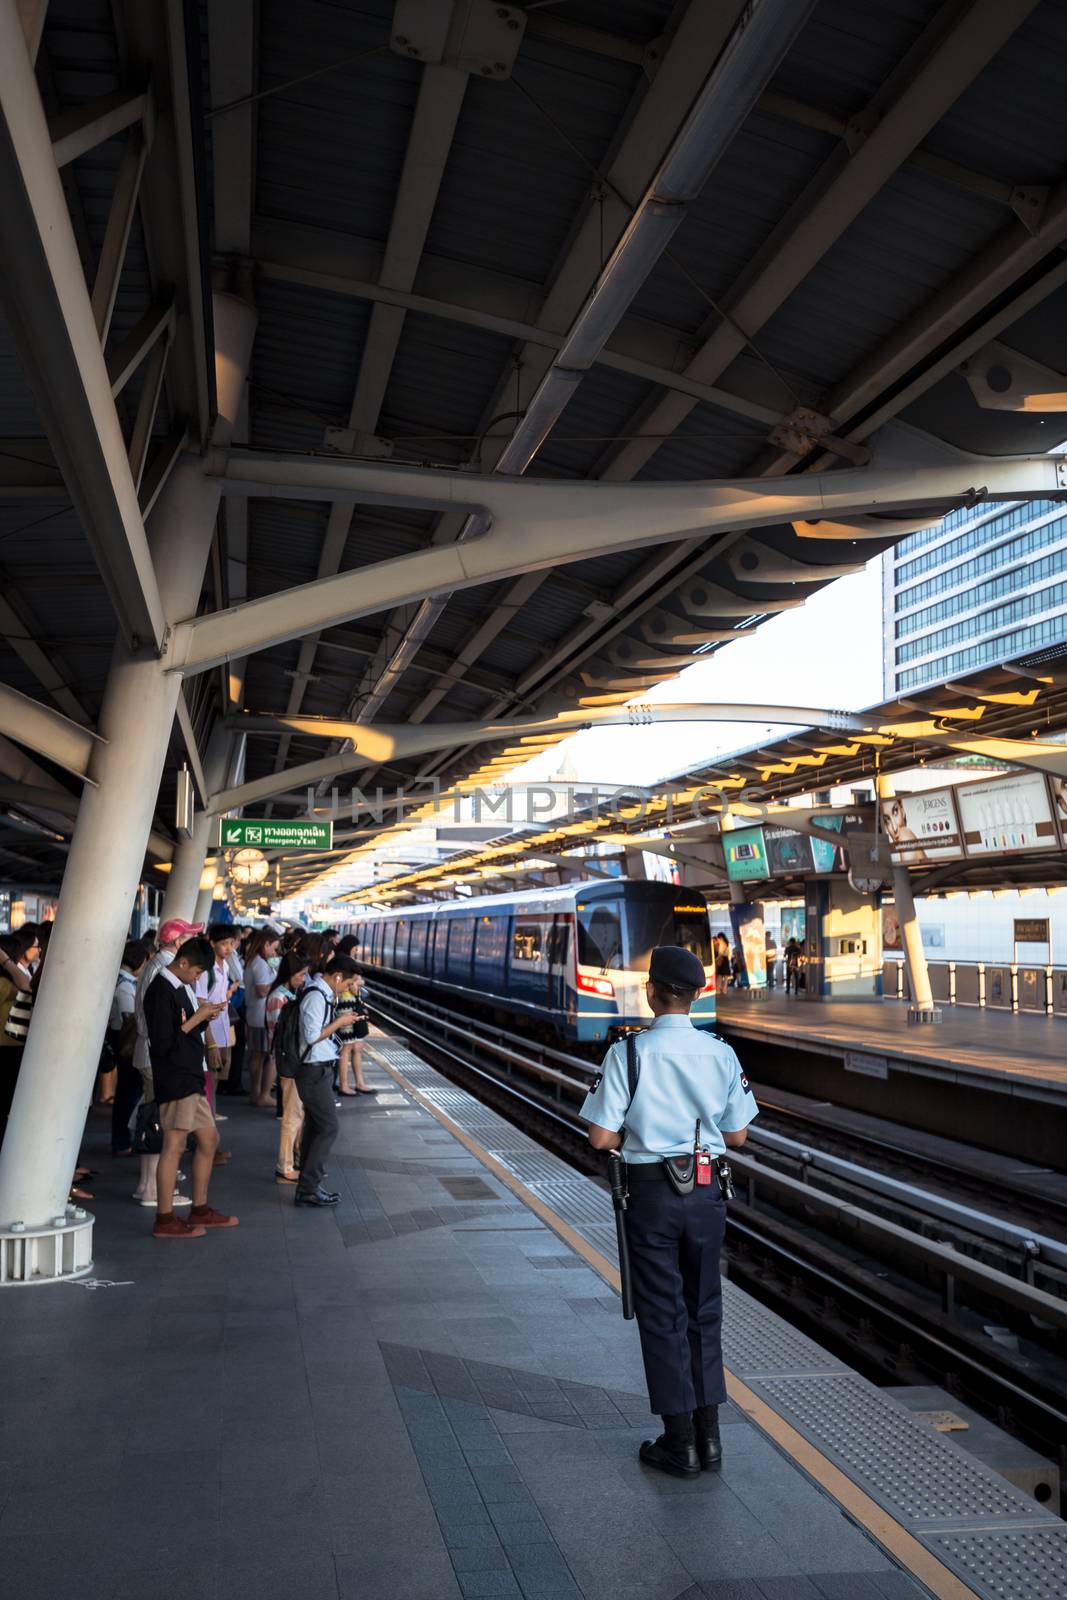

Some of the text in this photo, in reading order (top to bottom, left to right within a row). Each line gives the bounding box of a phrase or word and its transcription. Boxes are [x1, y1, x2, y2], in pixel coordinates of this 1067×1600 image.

[264, 825, 326, 840] ทางออกฉุกเฉิน
[264, 836, 302, 846] Emergency
